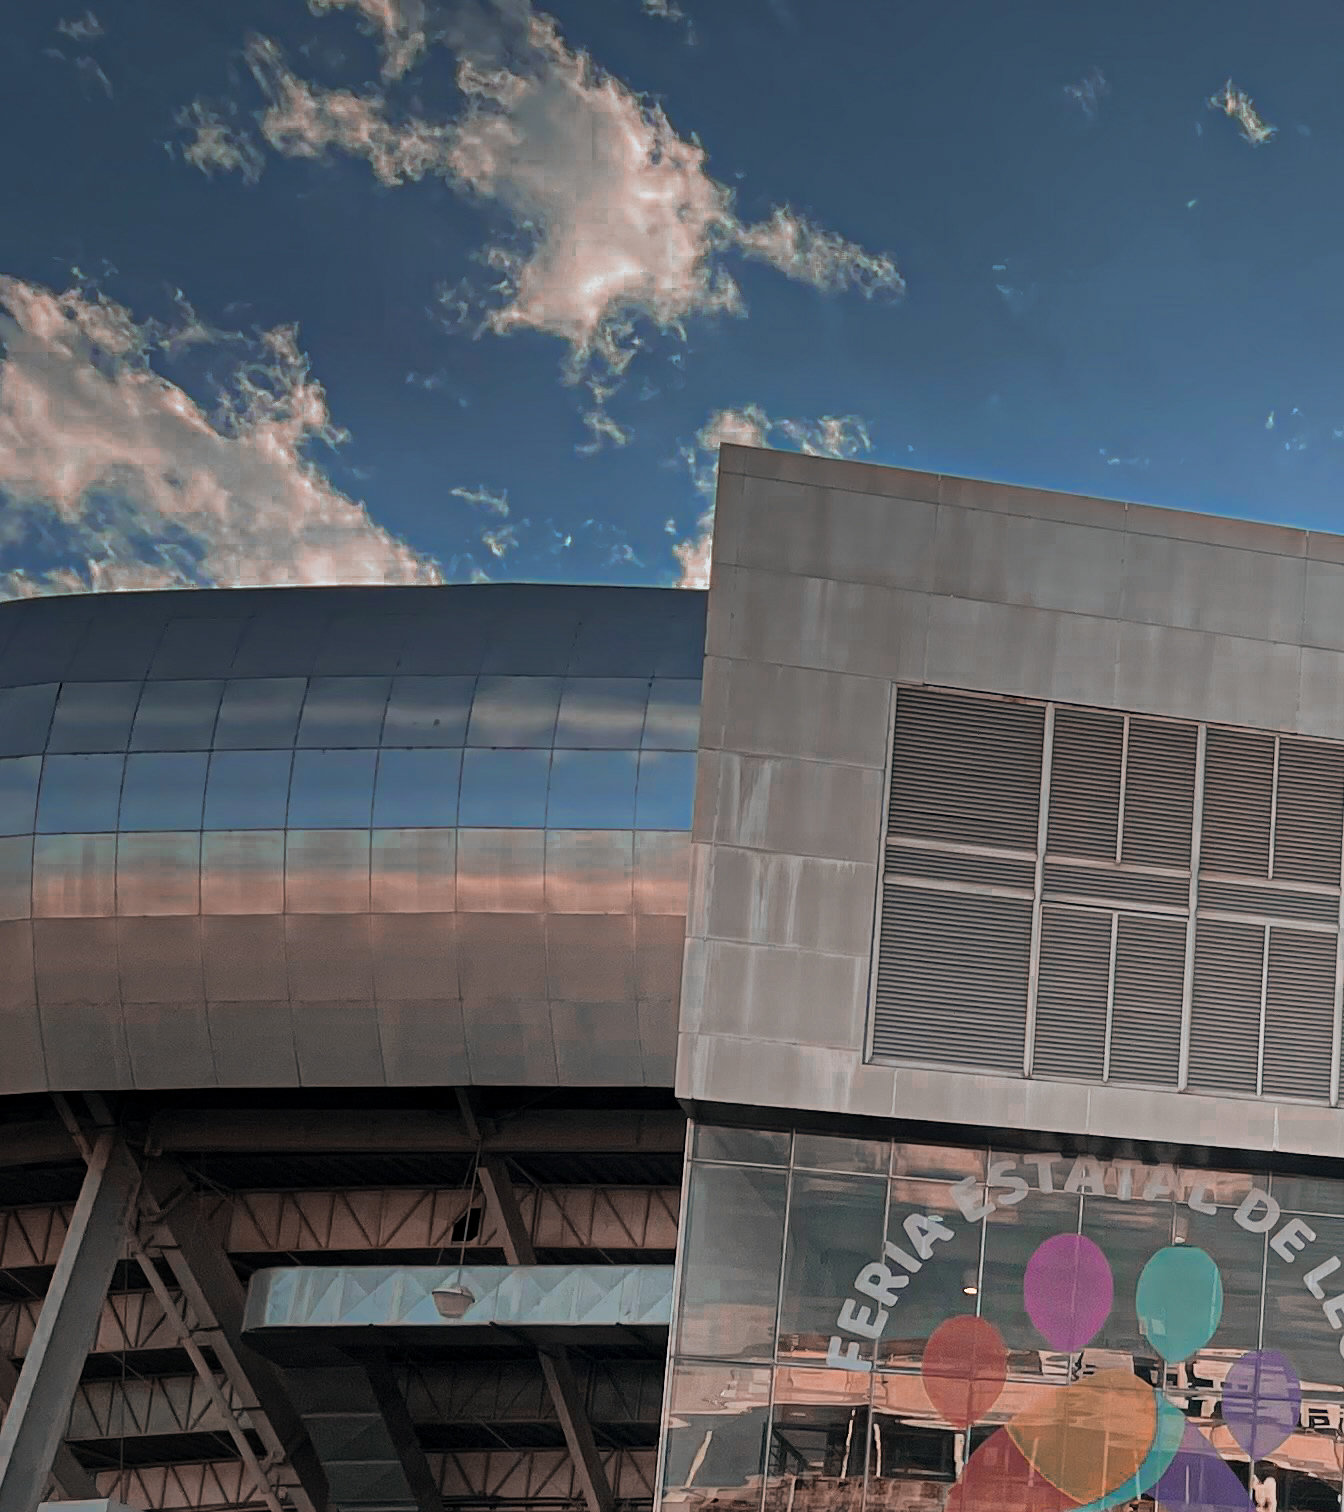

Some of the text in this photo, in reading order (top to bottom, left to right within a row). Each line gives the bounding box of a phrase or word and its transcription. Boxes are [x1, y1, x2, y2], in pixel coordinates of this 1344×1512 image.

[826, 1211, 955, 1374] FERIA
[948, 1150, 1220, 1224] ESTATAL
[1232, 1186, 1318, 1264] DE
